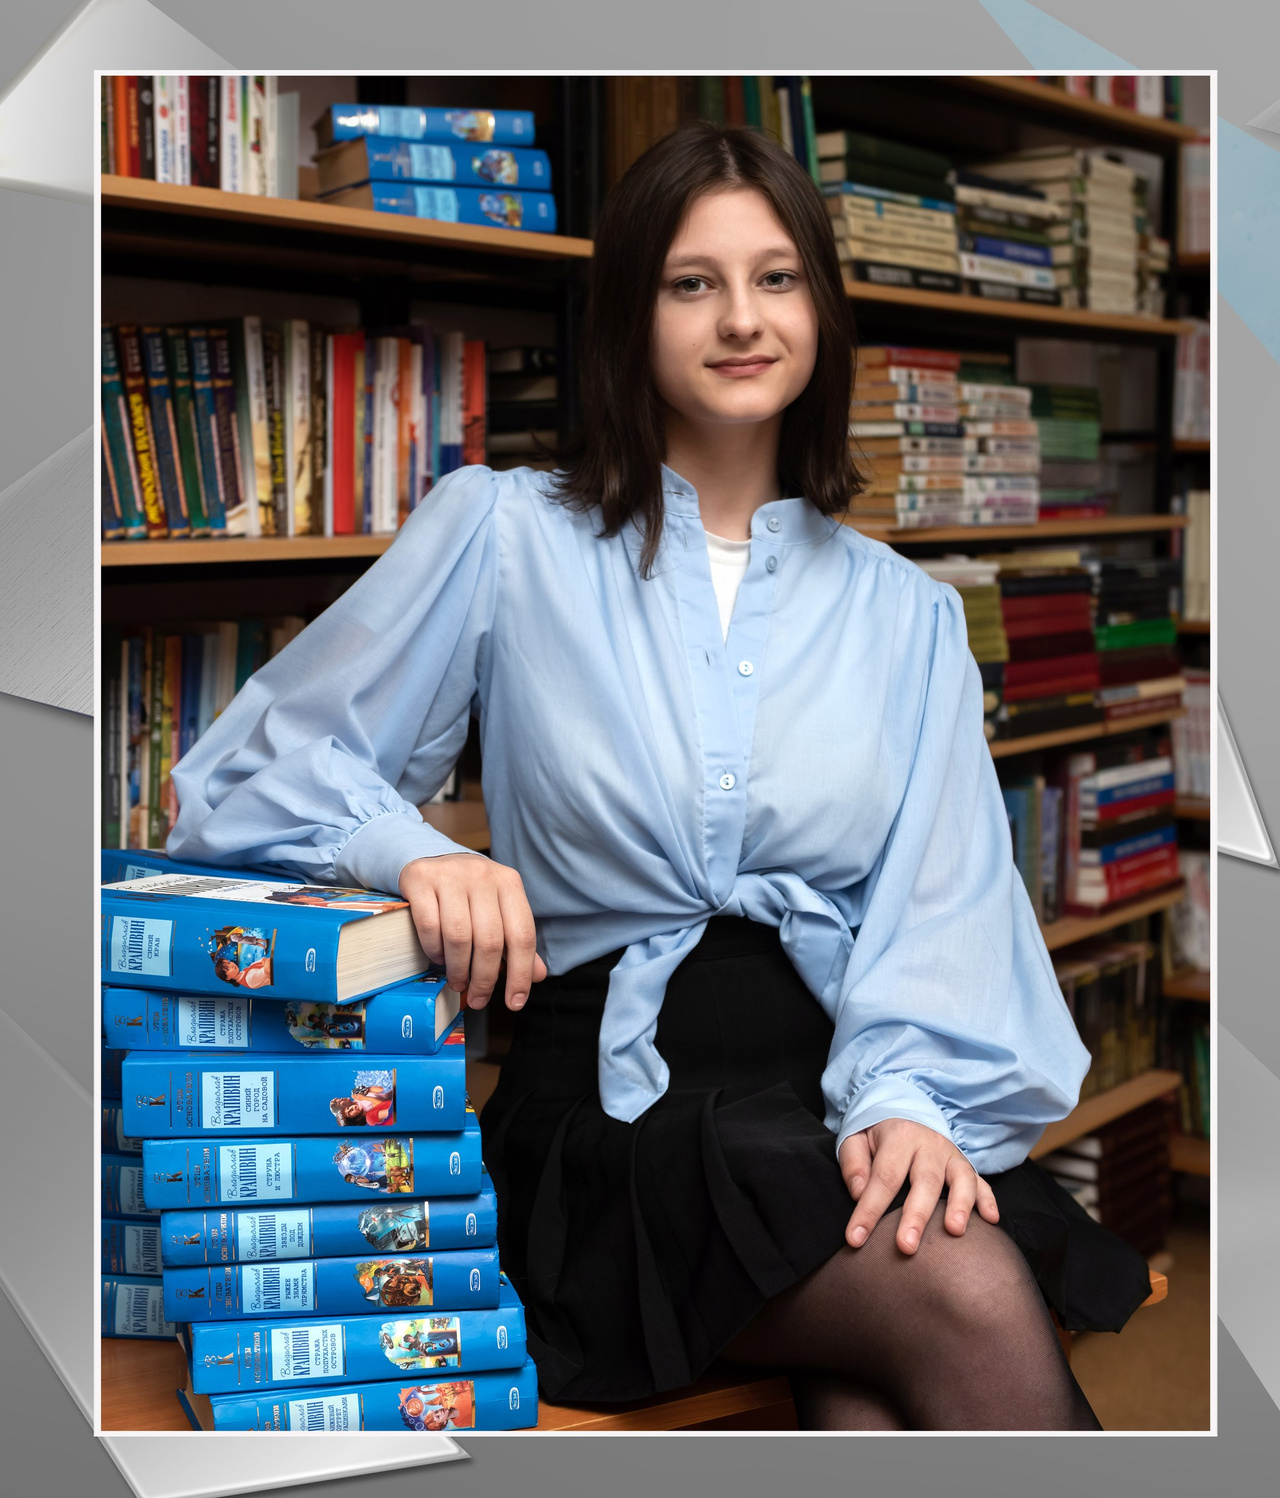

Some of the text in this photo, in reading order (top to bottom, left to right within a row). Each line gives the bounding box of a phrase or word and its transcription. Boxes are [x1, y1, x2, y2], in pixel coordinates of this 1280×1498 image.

[118, 918, 130, 970] Владислав
[128, 919, 146, 972] КРАПИВИН
[186, 1000, 197, 1044] Владислав
[198, 1000, 216, 1044] КРАПИВИН
[210, 1075, 221, 1127] Владислав
[223, 1075, 241, 1126] КРАПИВИН
[244, 1087, 252, 1113] СИНИЙ
[262, 1112, 268, 1123] НА
[227, 1149, 239, 1200] Владислав
[239, 1147, 258, 1198] КРАПИВИН
[132, 1228, 141, 1273] Владислав
[142, 1228, 158, 1273] КРАПИВИН
[220, 1213, 228, 1261] ОСНОВАТЕЛИ
[247, 1216, 258, 1259] Владислав
[258, 1214, 276, 1258] КРАПИВИН
[122, 1287, 133, 1334] Владислав
[132, 1288, 150, 1334] КРАПИВИН
[250, 1268, 261, 1311] Владислав
[263, 1266, 281, 1310] КРАПИВИН
[244, 1347, 252, 1369] ОТЦЫ
[280, 1331, 292, 1378] Владислав
[292, 1330, 311, 1377] КРАПИВИН
[322, 1328, 330, 1374] ЛОПУХАСТЫХ
